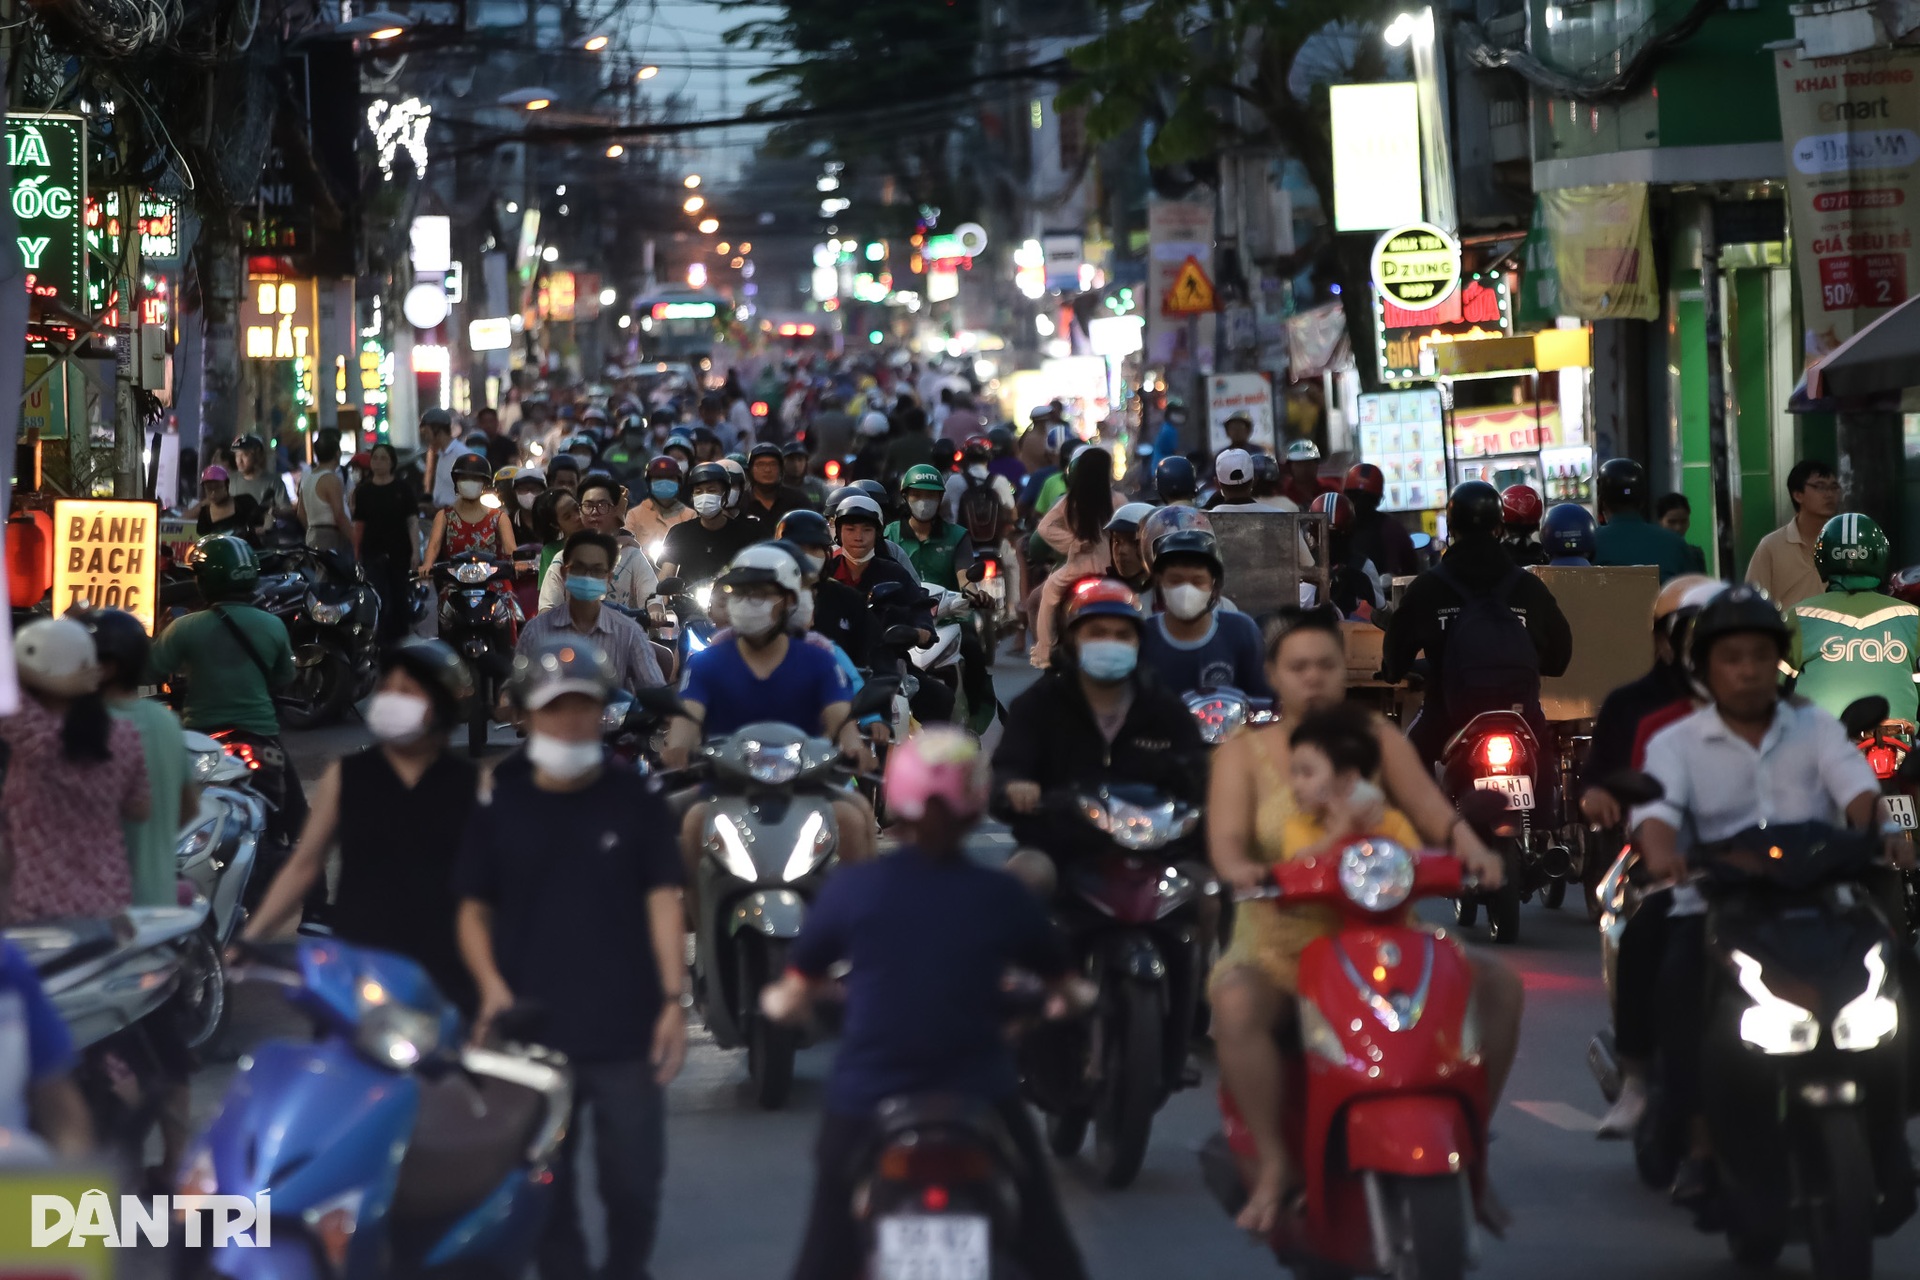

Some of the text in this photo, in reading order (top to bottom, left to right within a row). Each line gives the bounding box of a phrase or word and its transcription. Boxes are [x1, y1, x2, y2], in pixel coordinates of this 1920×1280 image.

[1795, 75, 1837, 93] KHAI
[1818, 96, 1890, 122] emart
[12, 175, 72, 219] ỐC
[1812, 235, 1844, 255] GIÁ
[1847, 231, 1884, 251] SIÊU
[1381, 260, 1452, 278] DZUNG
[1876, 280, 1893, 303] 2
[68, 510, 147, 543] BÁNH
[1831, 544, 1869, 560] Grab
[1819, 630, 1908, 664] Grab
